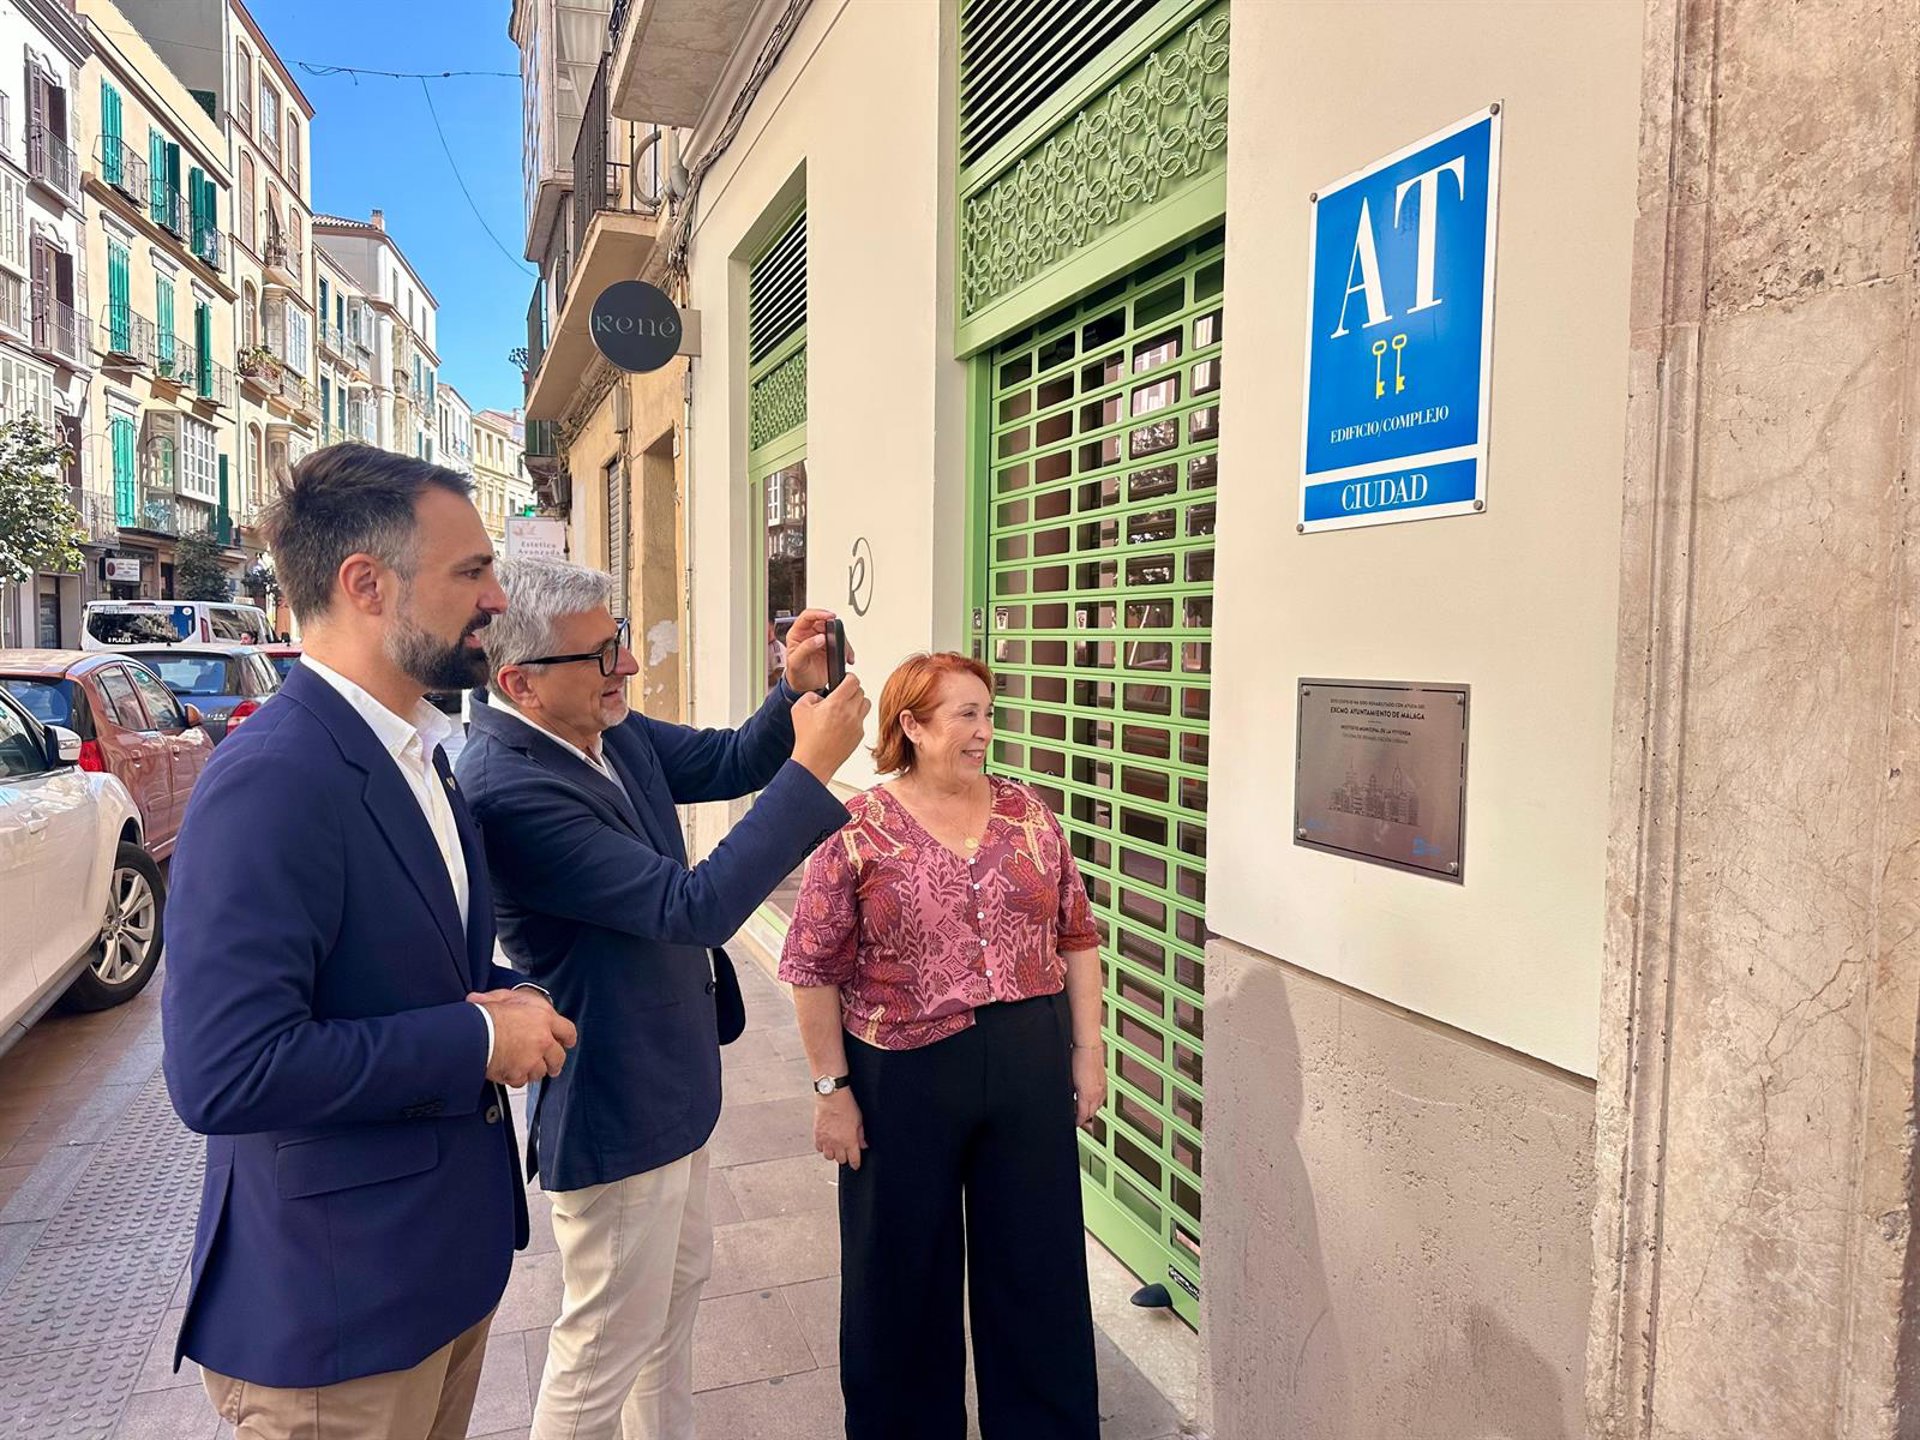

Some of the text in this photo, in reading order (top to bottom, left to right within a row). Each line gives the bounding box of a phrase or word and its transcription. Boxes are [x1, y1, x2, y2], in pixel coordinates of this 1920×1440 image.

[1331, 155, 1465, 339] AT
[1330, 405, 1449, 444] EDIFICIO/COMPLEJO
[1342, 473, 1428, 511] CIUDAD
[1392, 711, 1400, 719] DE
